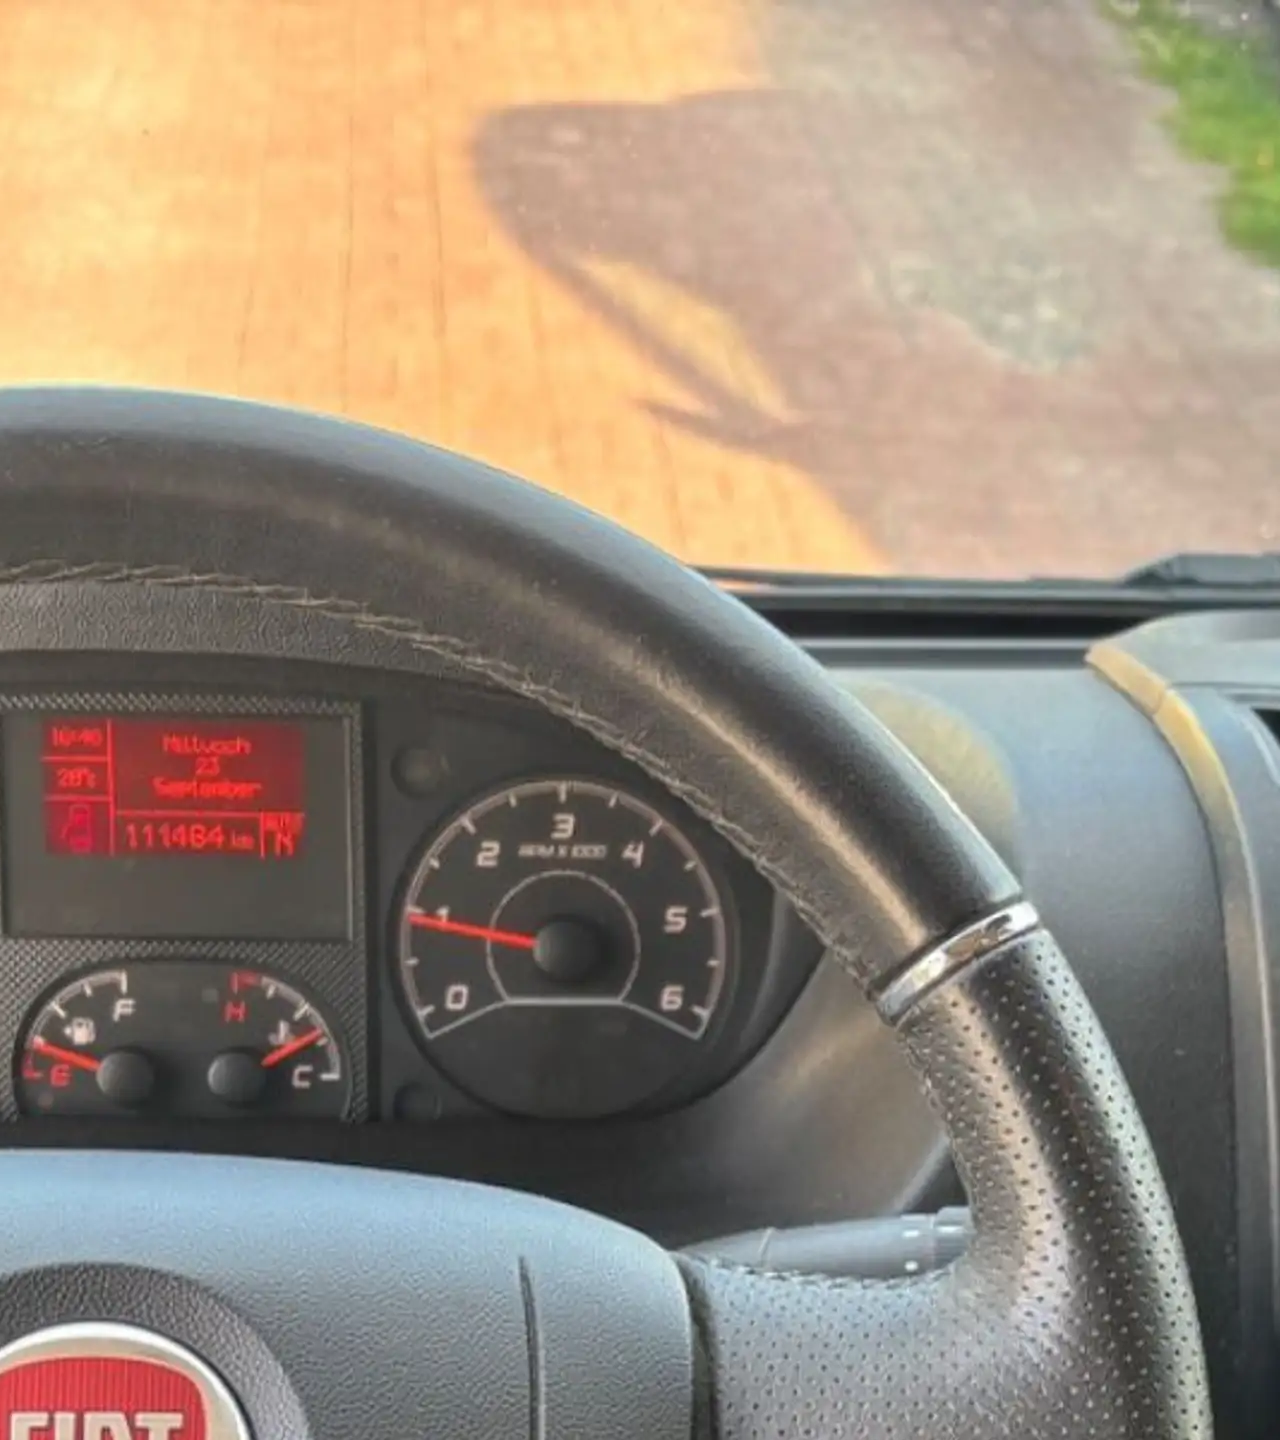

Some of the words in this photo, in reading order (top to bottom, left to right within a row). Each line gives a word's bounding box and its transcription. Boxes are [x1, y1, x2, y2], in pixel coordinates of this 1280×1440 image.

[551, 814, 576, 839] 3
[476, 841, 500, 867] 2
[622, 842, 645, 868] 4
[664, 905, 689, 932] 5
[445, 984, 470, 1010] 0
[661, 984, 685, 1011] 6
[113, 999, 136, 1022] F
[292, 1065, 313, 1088] C
